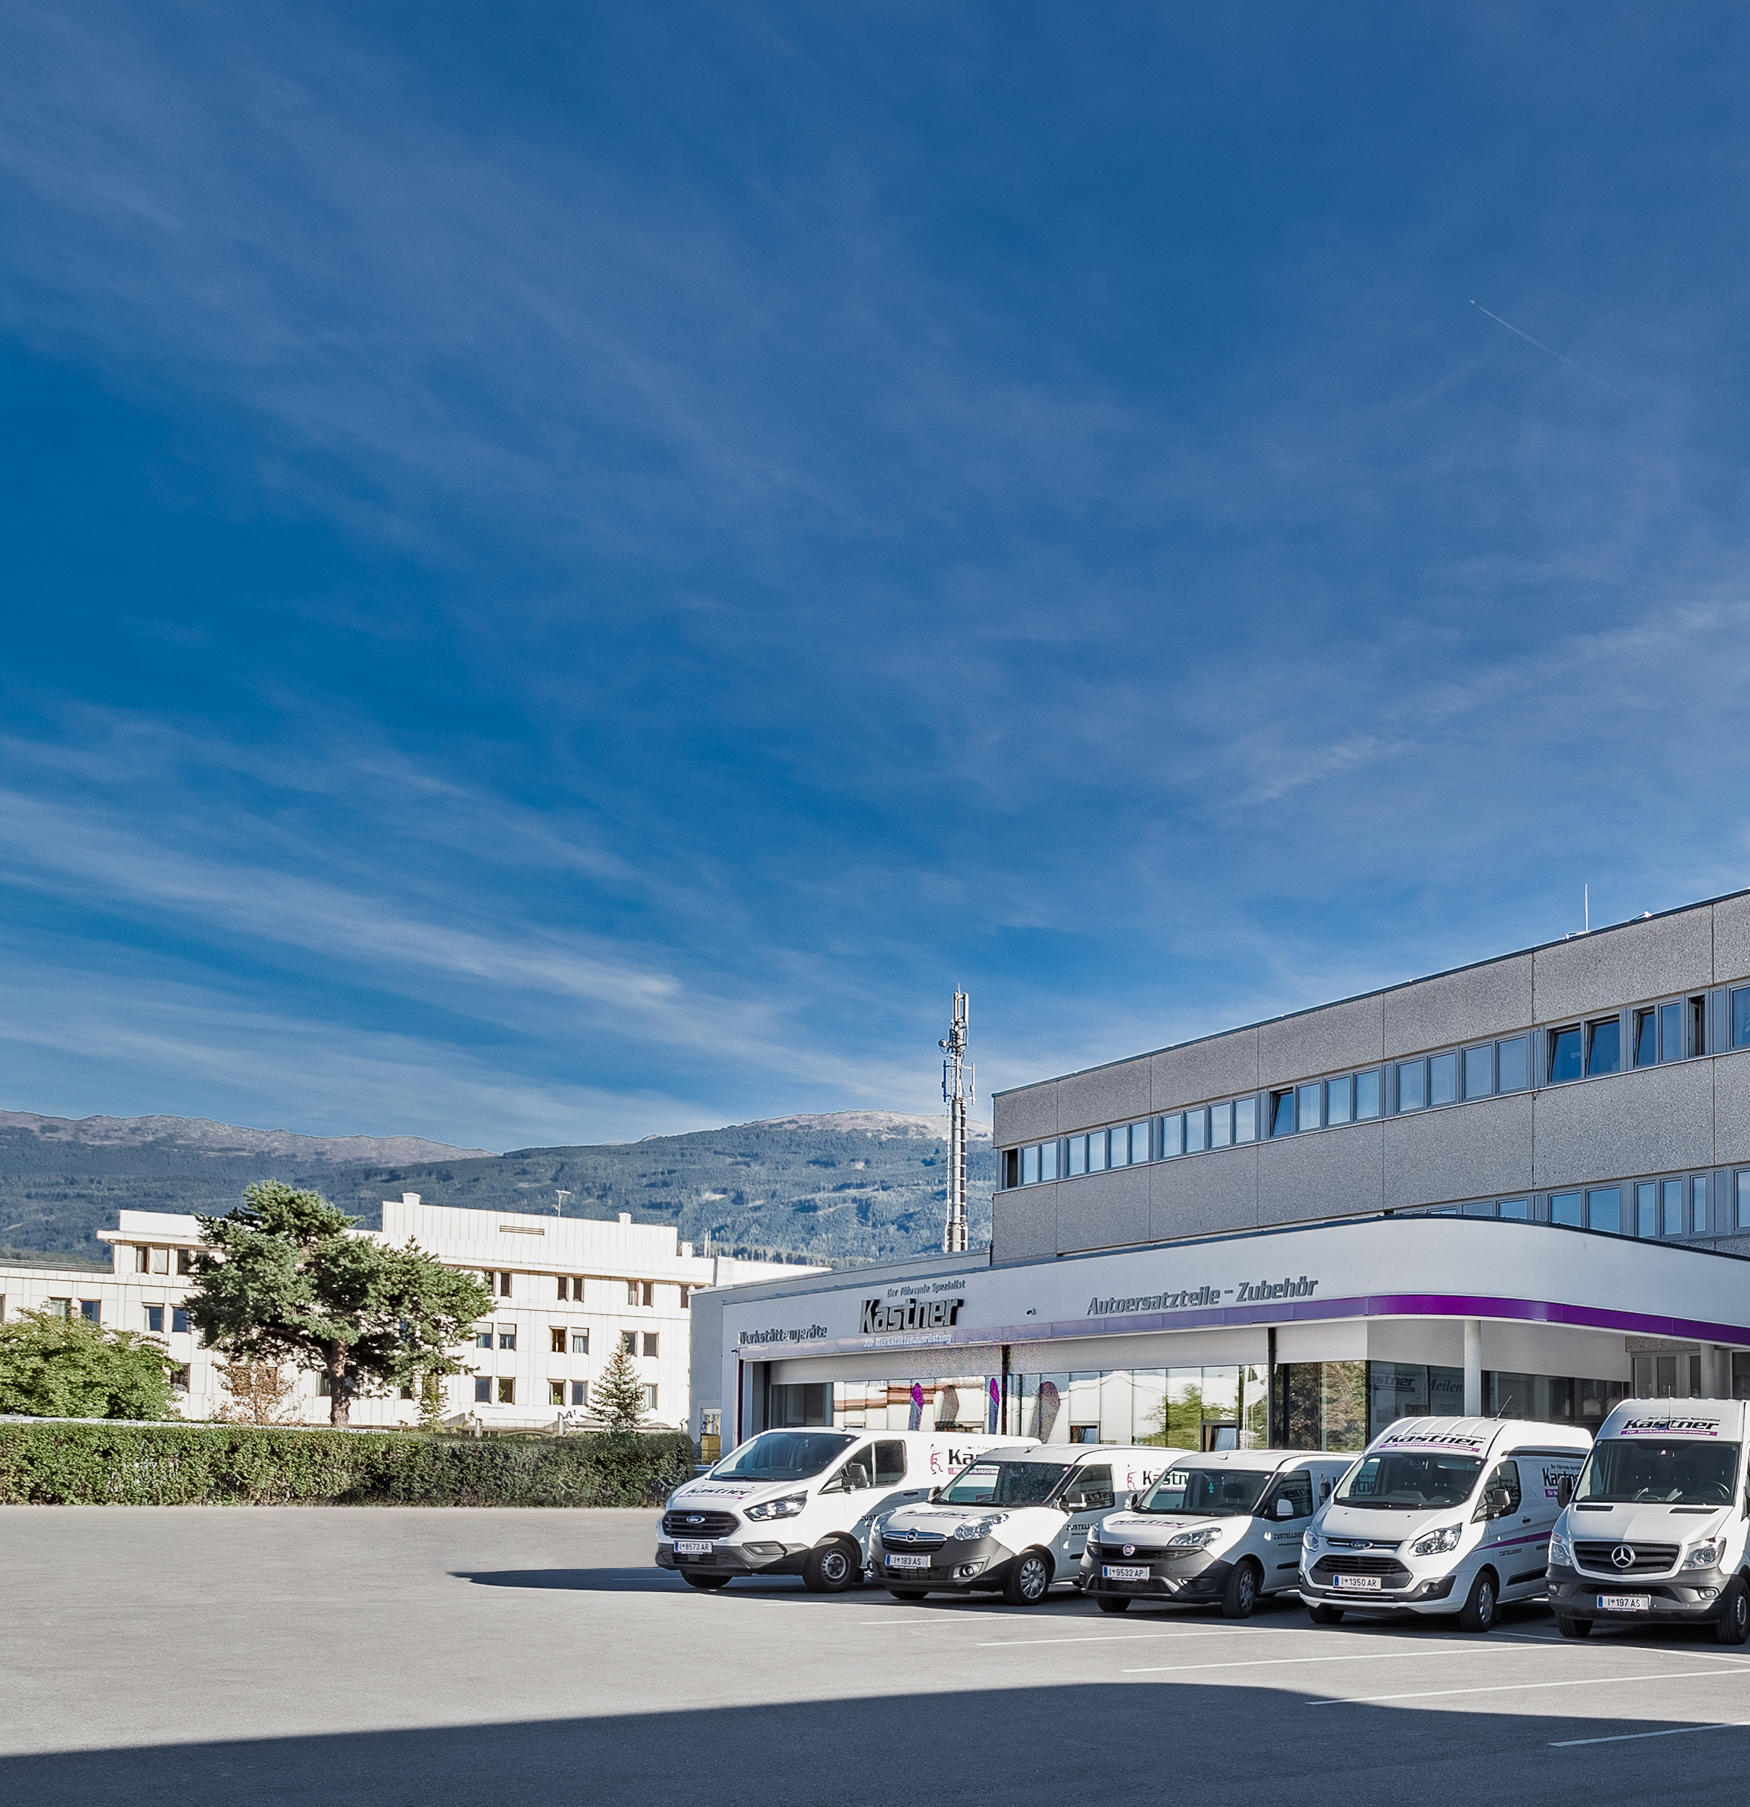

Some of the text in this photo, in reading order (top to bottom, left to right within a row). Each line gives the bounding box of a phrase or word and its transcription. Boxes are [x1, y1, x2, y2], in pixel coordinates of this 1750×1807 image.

[1086, 1286, 1220, 1315] Autoersatzteile
[1235, 1276, 1318, 1303] Zubehör
[860, 1298, 964, 1333] Kastner
[1623, 1419, 1719, 1430] Kastner
[1384, 1434, 1484, 1446] Kastner
